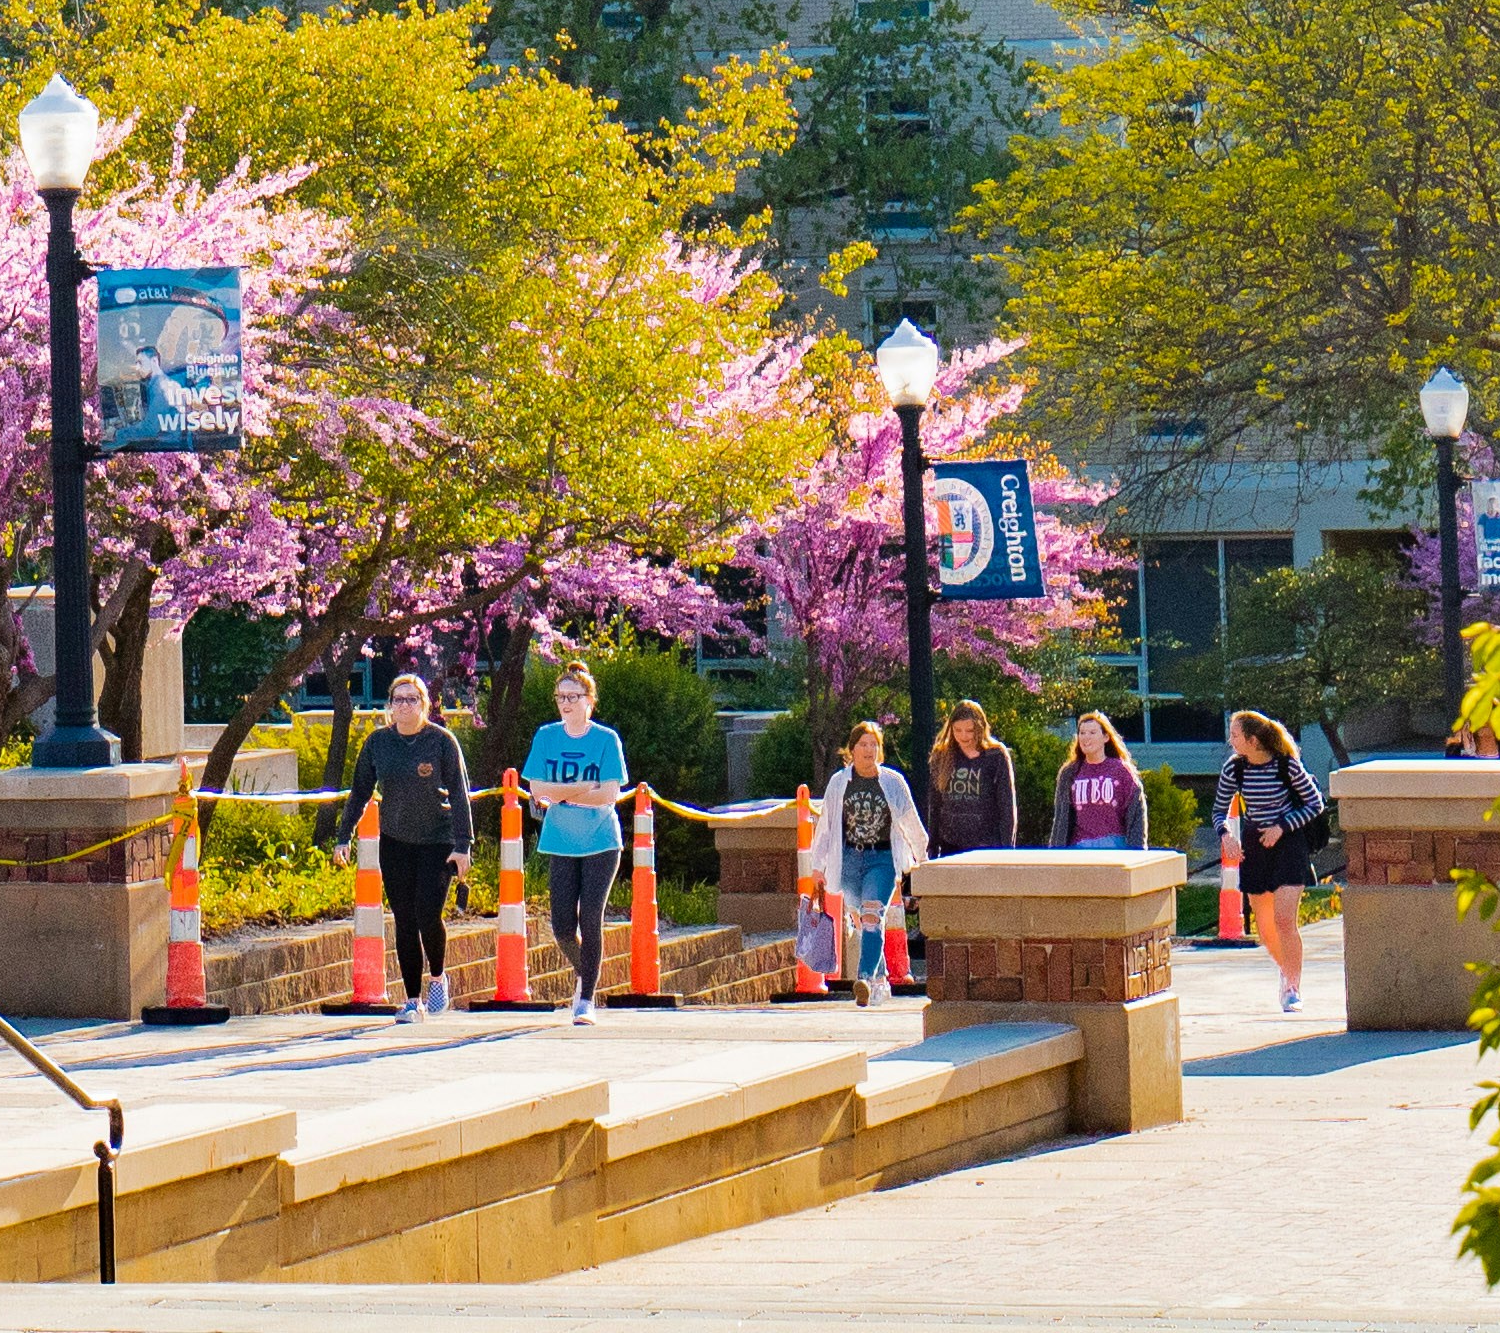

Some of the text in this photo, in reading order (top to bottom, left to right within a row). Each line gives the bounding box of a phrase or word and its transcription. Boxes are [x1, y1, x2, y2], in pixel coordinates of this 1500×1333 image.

[138, 286, 169, 300] at&t
[185, 353, 239, 367] Creighton
[186, 365, 239, 379] Bluejays
[157, 405, 240, 435] wisely
[998, 474, 1027, 582] Creighton
